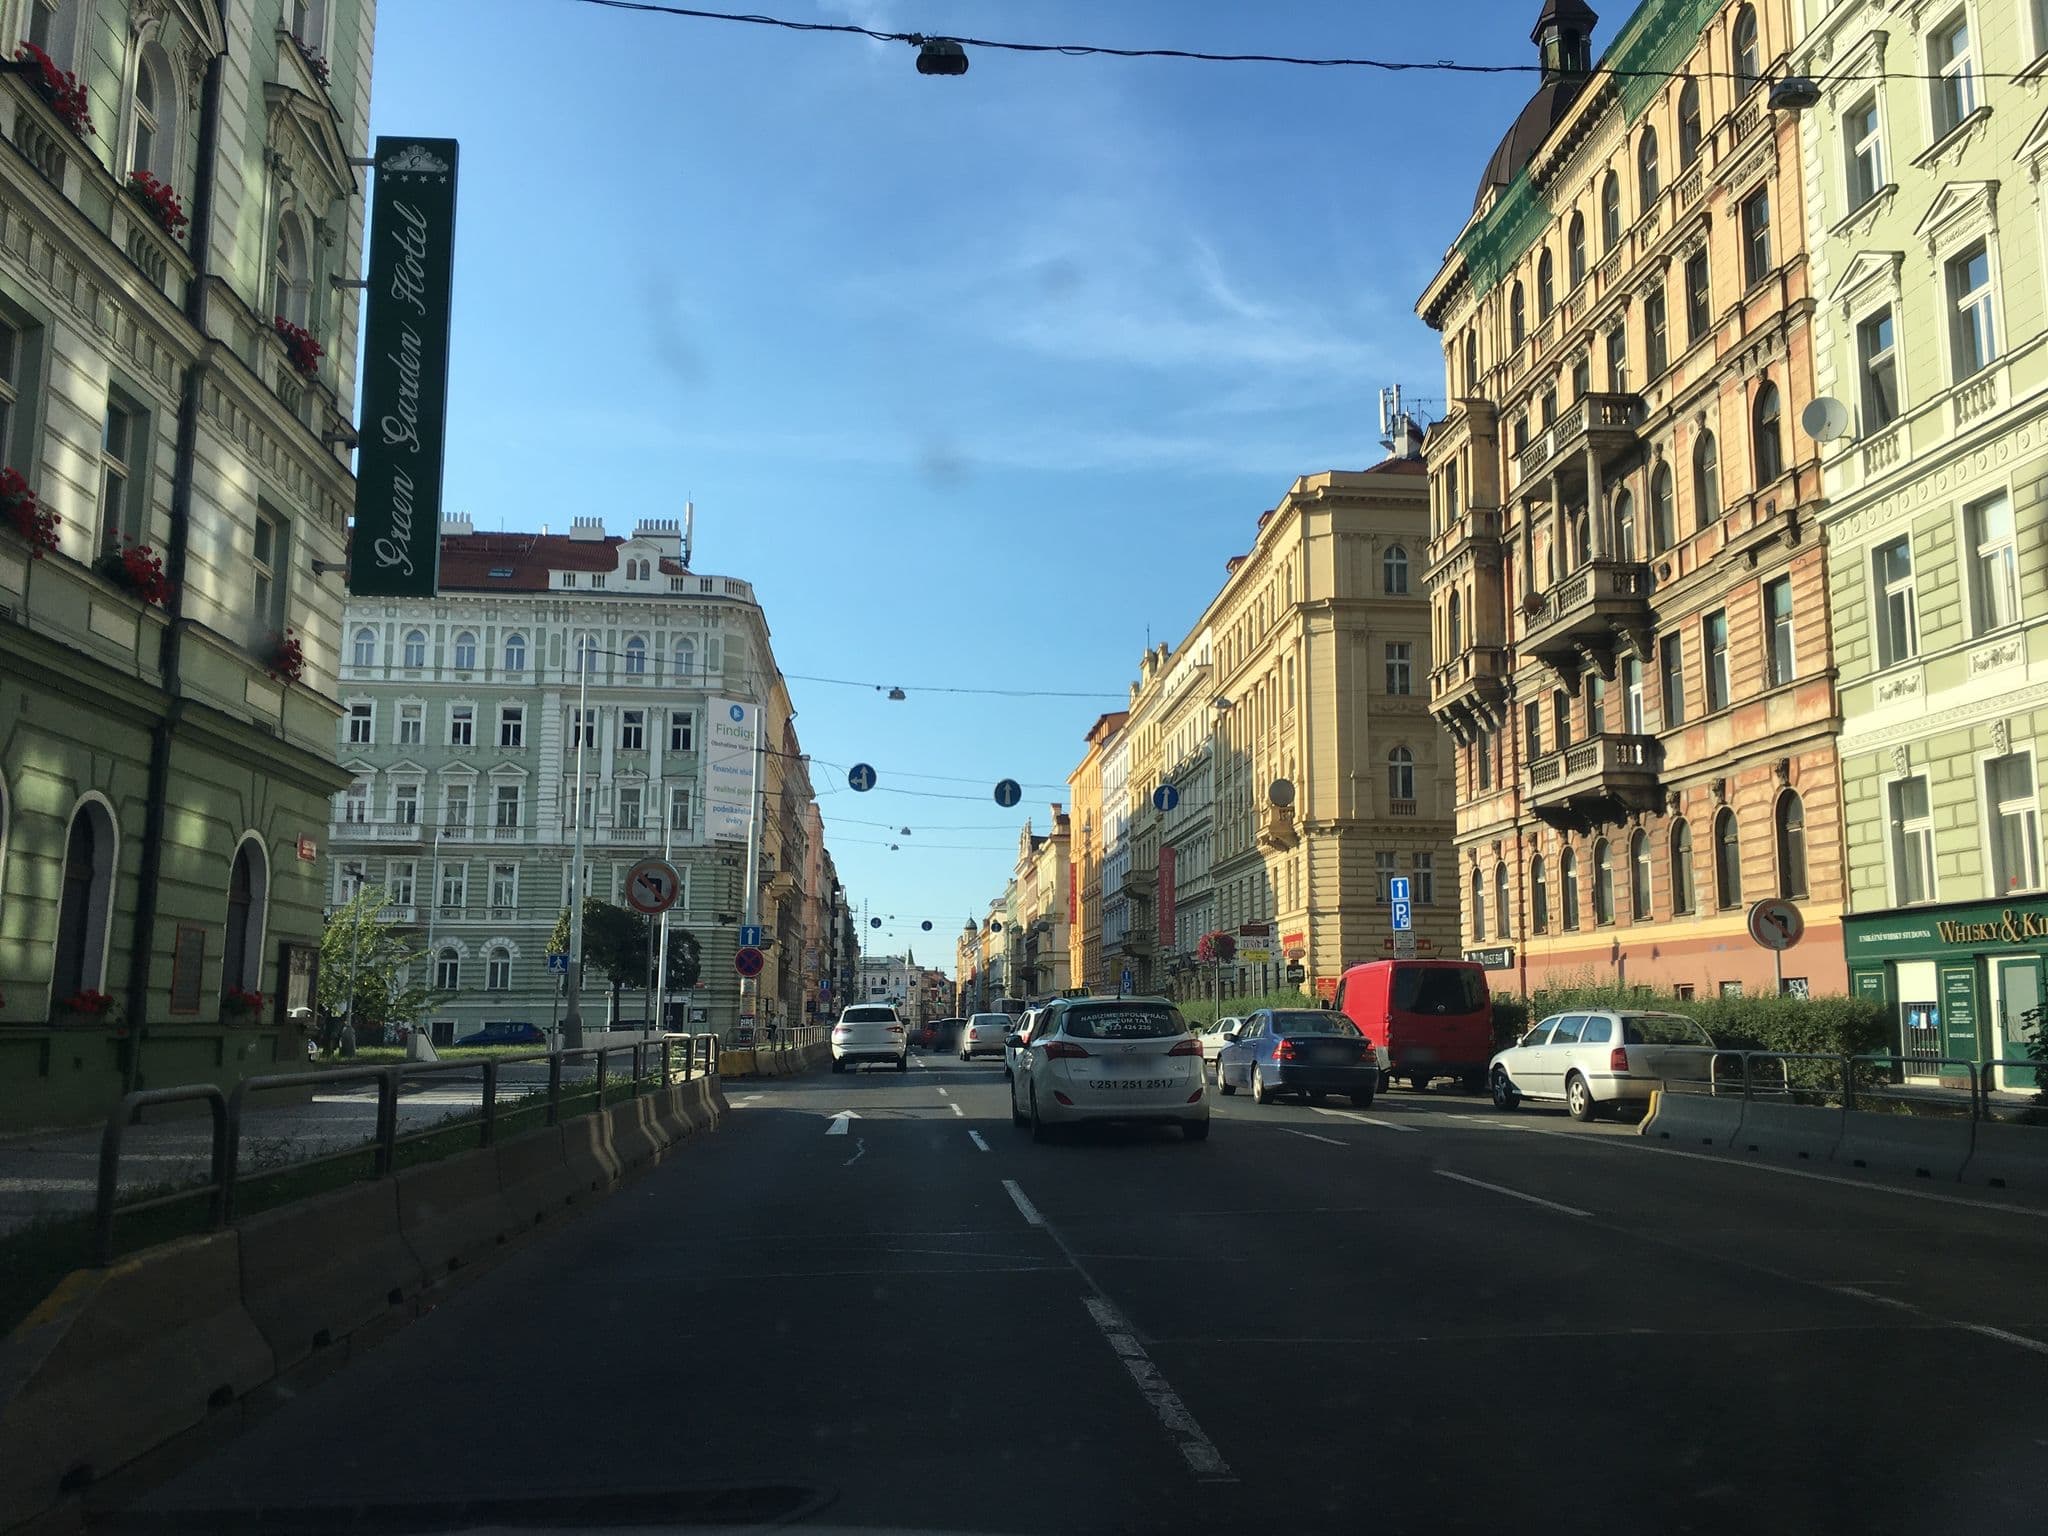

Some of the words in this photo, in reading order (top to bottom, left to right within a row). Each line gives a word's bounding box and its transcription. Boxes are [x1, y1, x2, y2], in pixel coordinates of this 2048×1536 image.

[389, 198, 429, 316] Hotel
[380, 320, 423, 453] Garden
[374, 463, 417, 577] Green
[1395, 903, 1407, 921] P
[2000, 908, 2022, 943] &
[1064, 988, 1087, 998] TAXI
[1097, 1080, 1117, 1089] 251
[1122, 1080, 1142, 1089] 251
[1146, 1079, 1166, 1089] 251
